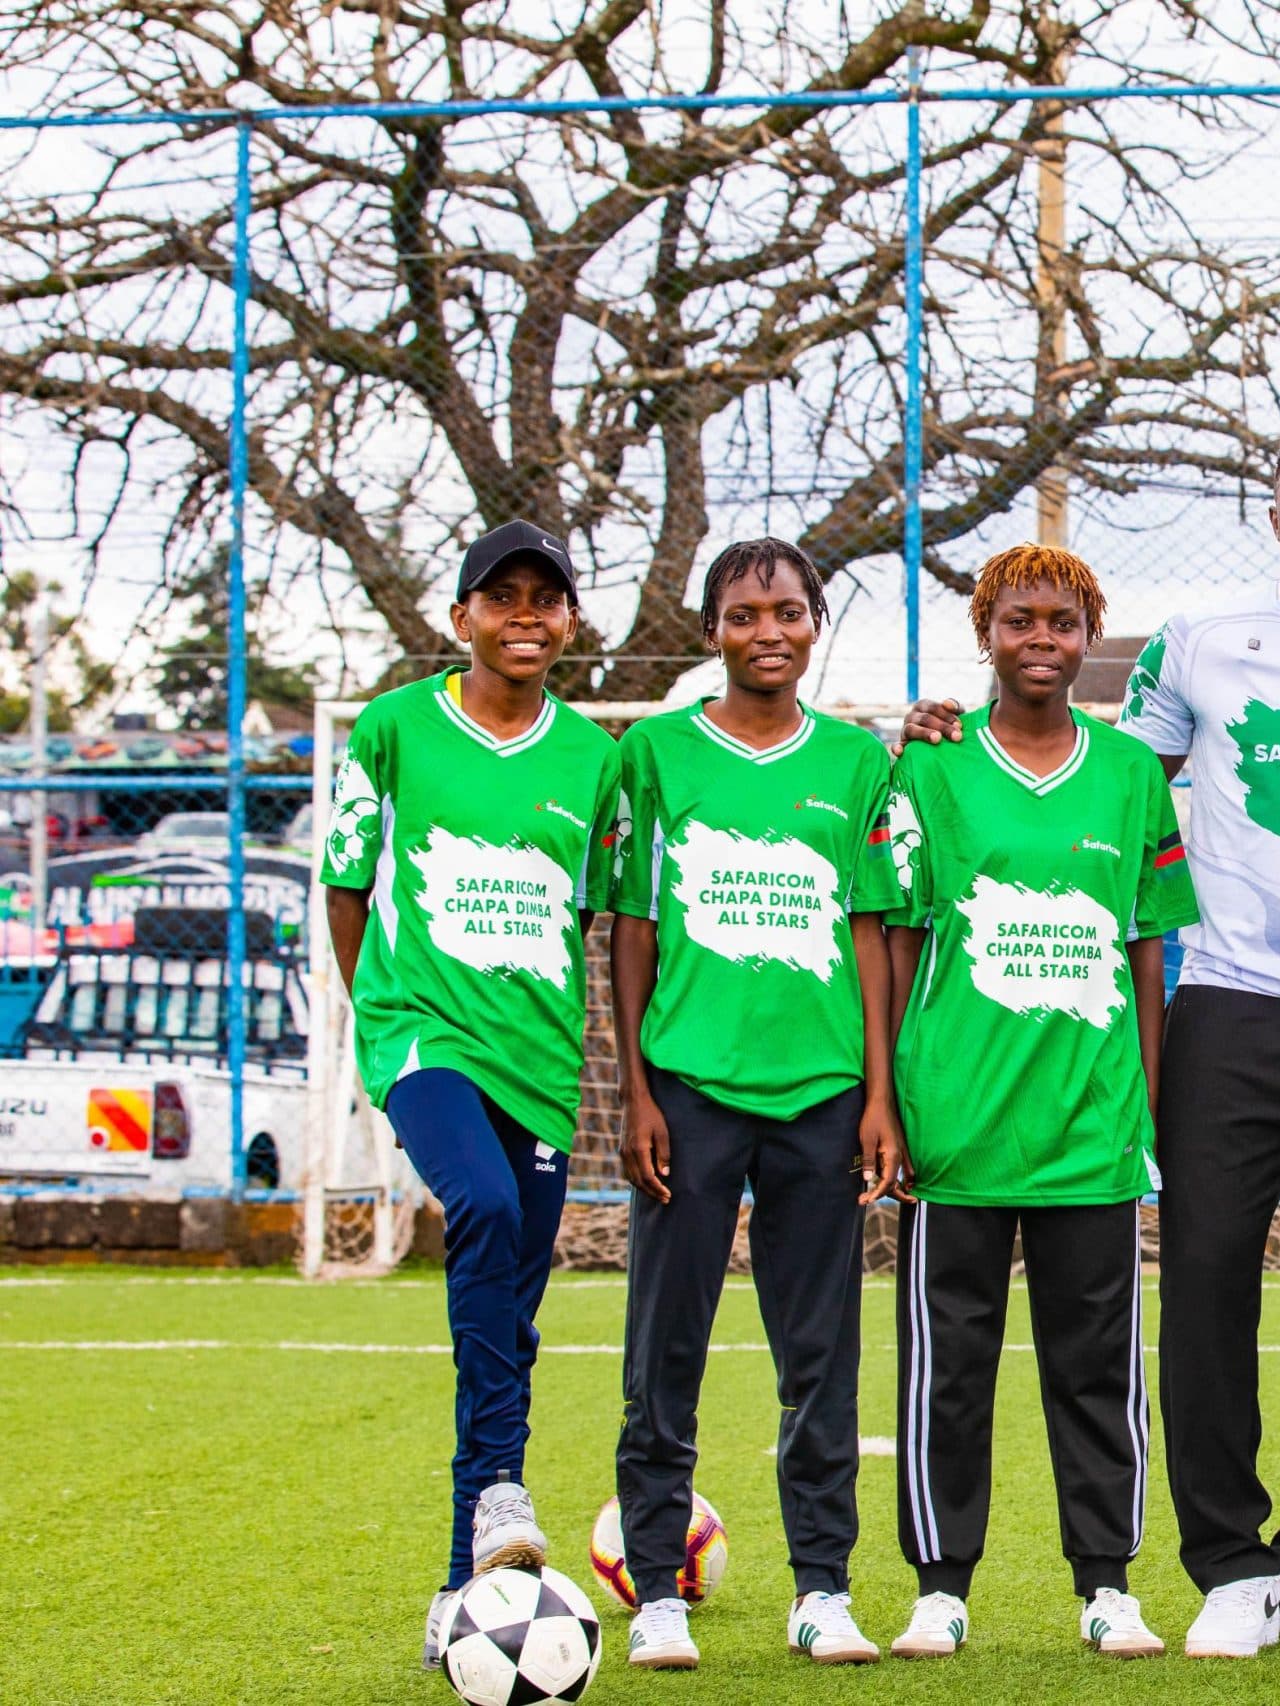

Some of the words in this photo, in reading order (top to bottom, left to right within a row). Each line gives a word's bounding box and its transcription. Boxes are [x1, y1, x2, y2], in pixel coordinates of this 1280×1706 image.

[456, 878, 547, 898] SAFARICOM
[711, 870, 815, 890] SAFARICOM
[444, 898, 509, 914] CHAPA
[516, 902, 552, 919] DIMBA
[699, 890, 762, 905] CHAPA
[769, 892, 822, 911] DIMBA
[464, 919, 497, 934] ALL
[503, 921, 543, 938] STARS
[718, 911, 749, 925] ALL
[756, 912, 809, 929] STARS
[997, 923, 1097, 940] SAFARICOM
[986, 943, 1046, 957] CHAPA
[1053, 944, 1102, 960] DIMBA
[1003, 963, 1033, 977] ALL
[1039, 964, 1089, 979] STARS
